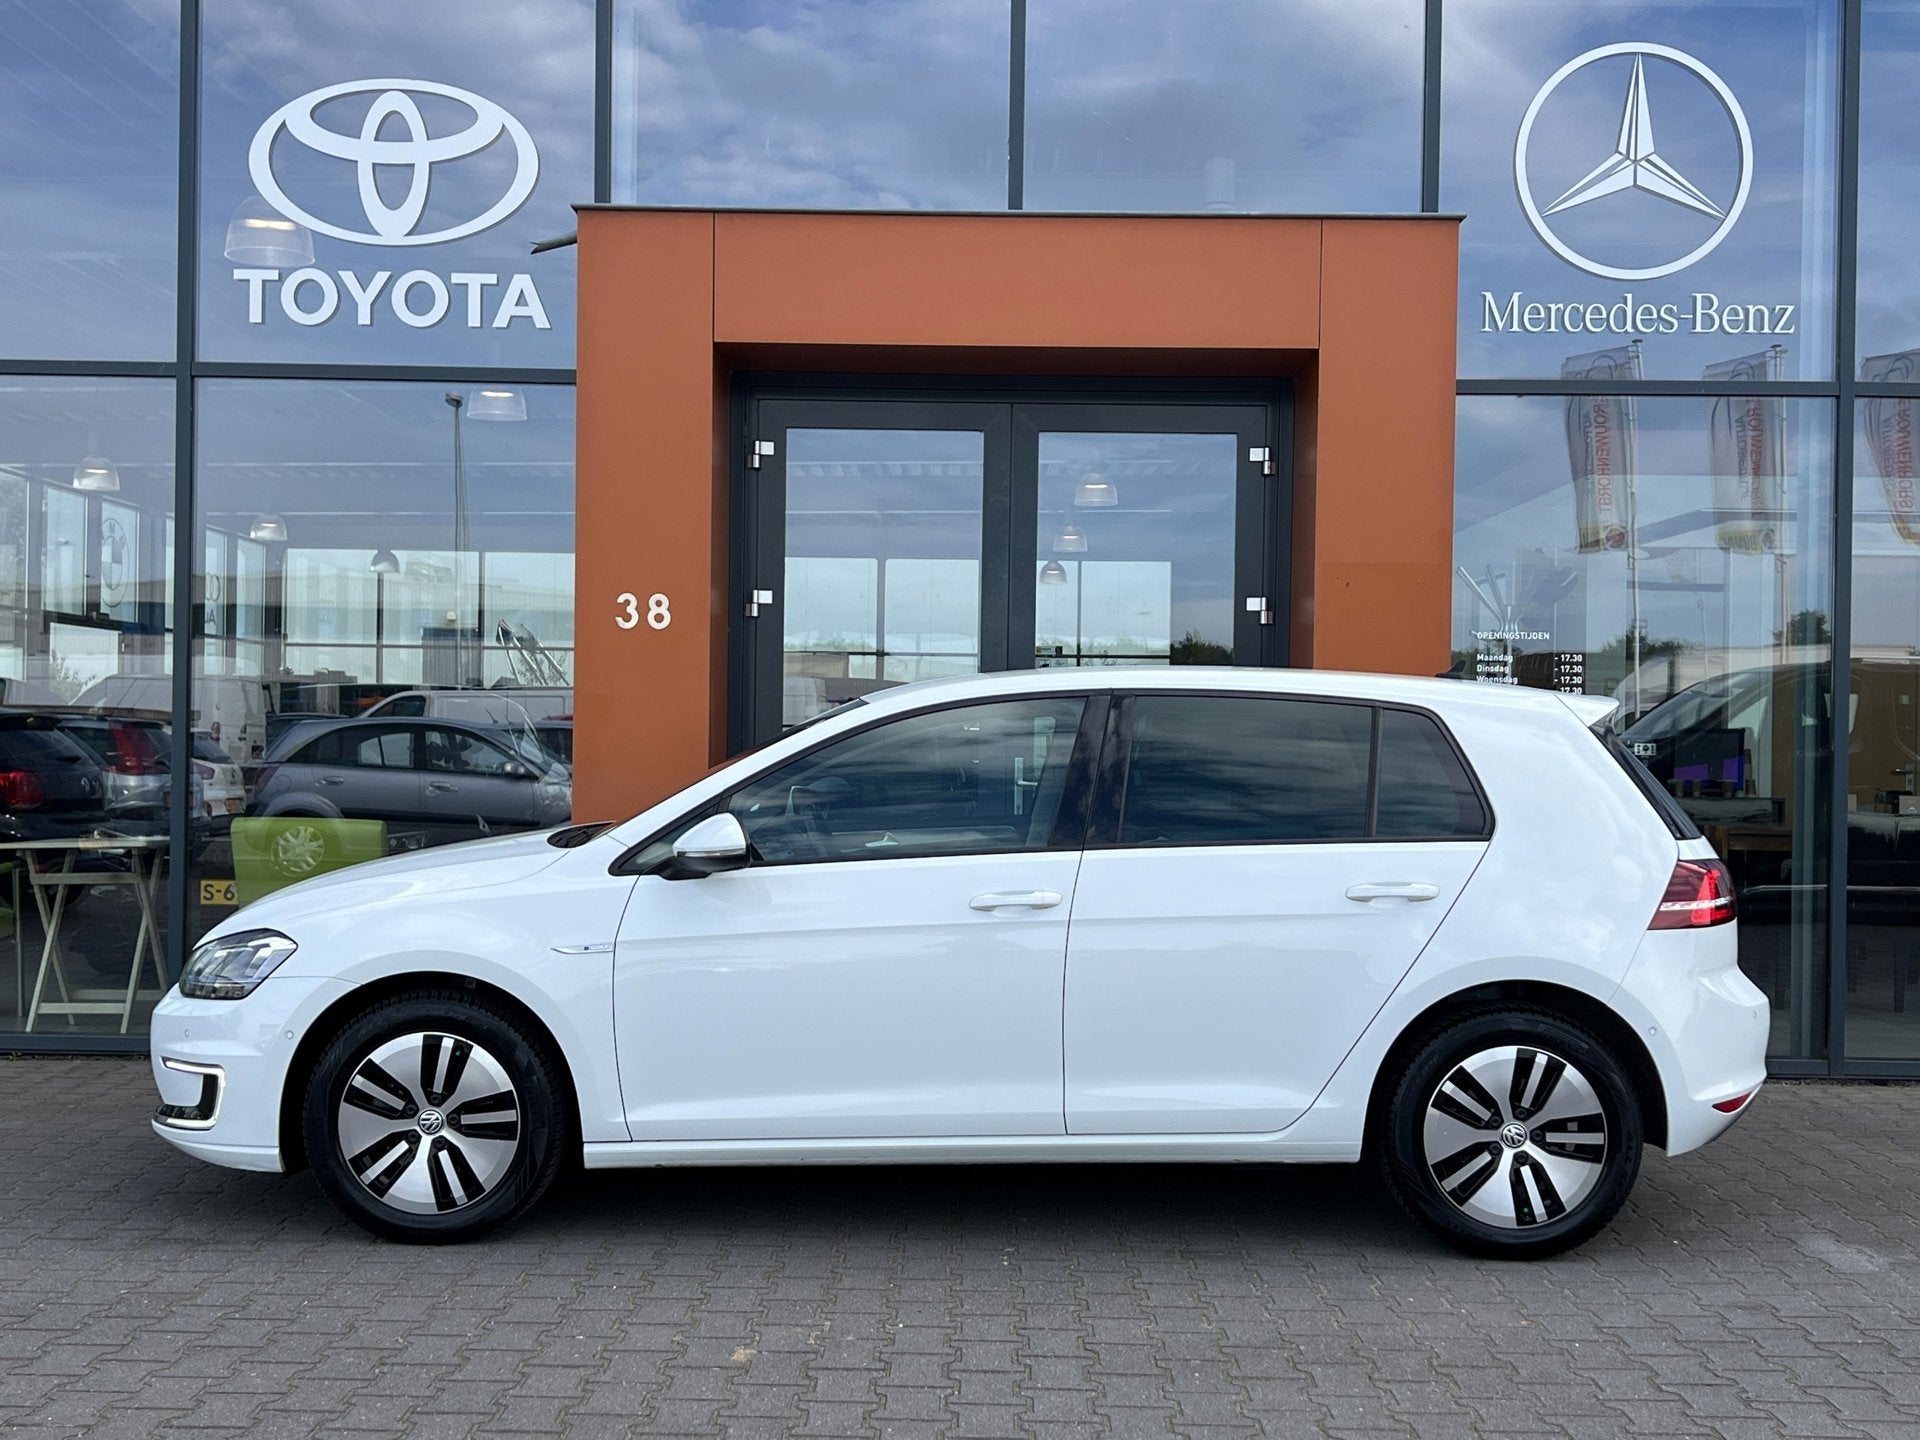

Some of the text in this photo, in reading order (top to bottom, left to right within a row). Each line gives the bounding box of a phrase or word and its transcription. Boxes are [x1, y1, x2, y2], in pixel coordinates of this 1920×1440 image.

[233, 268, 551, 329] TOYOTA
[1480, 291, 1796, 334] Mercedes-Benz
[615, 592, 671, 630] 38
[1476, 631, 1550, 640] OPENINGSTIJDEN
[1476, 653, 1513, 662] Maandag
[1560, 654, 1583, 662] 17.30
[1476, 665, 1510, 673] Dinsdag
[1560, 665, 1583, 673] 17.30
[1560, 676, 1583, 684] 17.30
